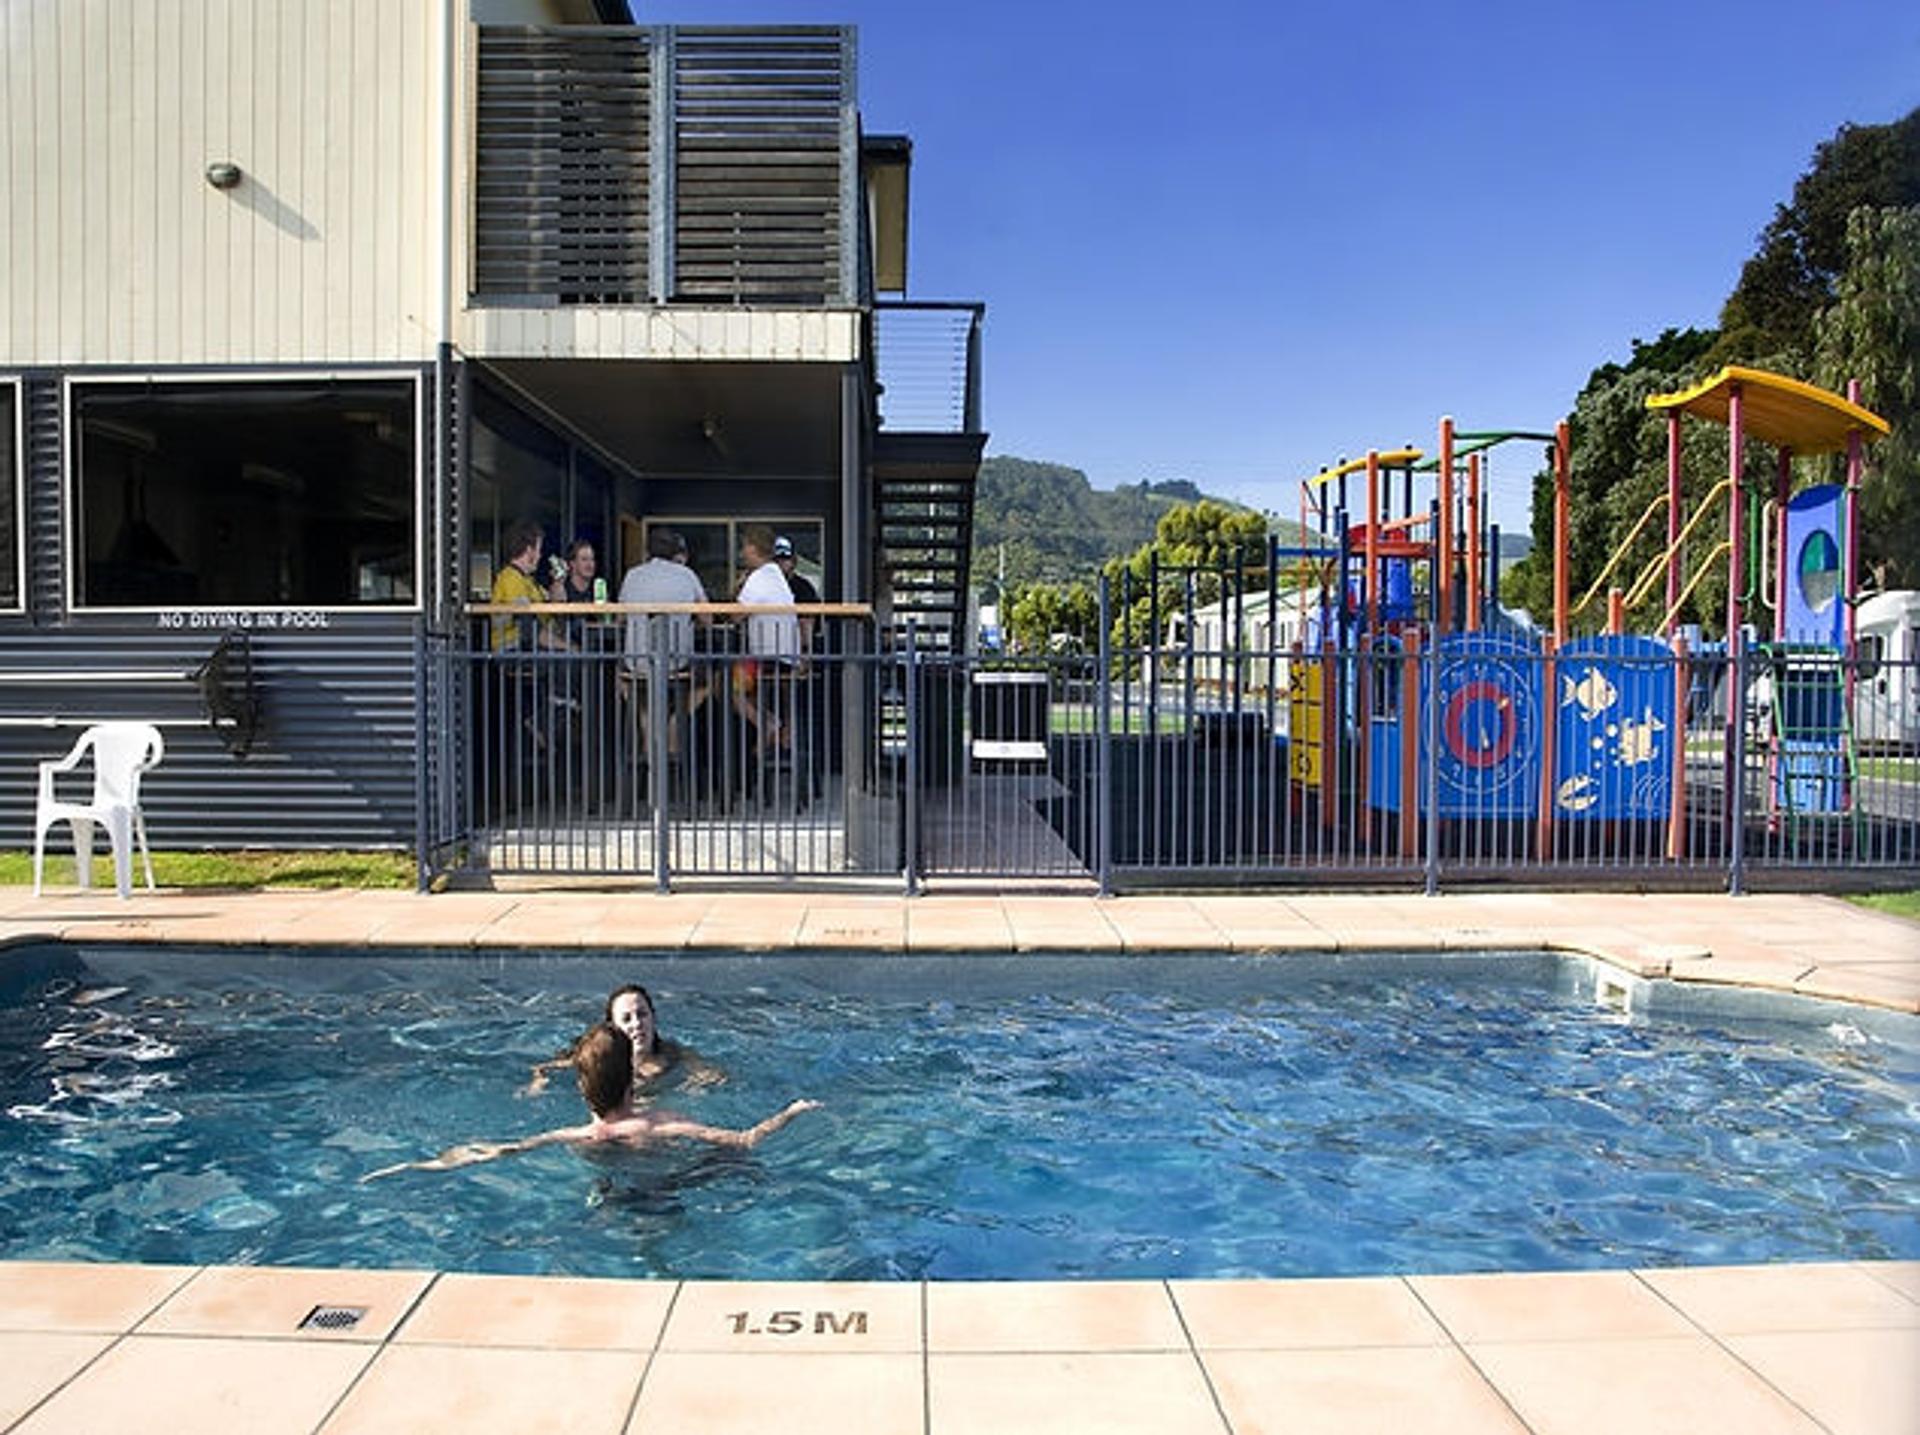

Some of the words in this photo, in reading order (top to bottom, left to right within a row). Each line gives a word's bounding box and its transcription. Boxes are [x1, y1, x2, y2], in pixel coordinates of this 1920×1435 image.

[158, 612, 184, 628] NO
[189, 612, 252, 628] DIVING
[257, 612, 277, 628] IN
[281, 611, 331, 628] POOL
